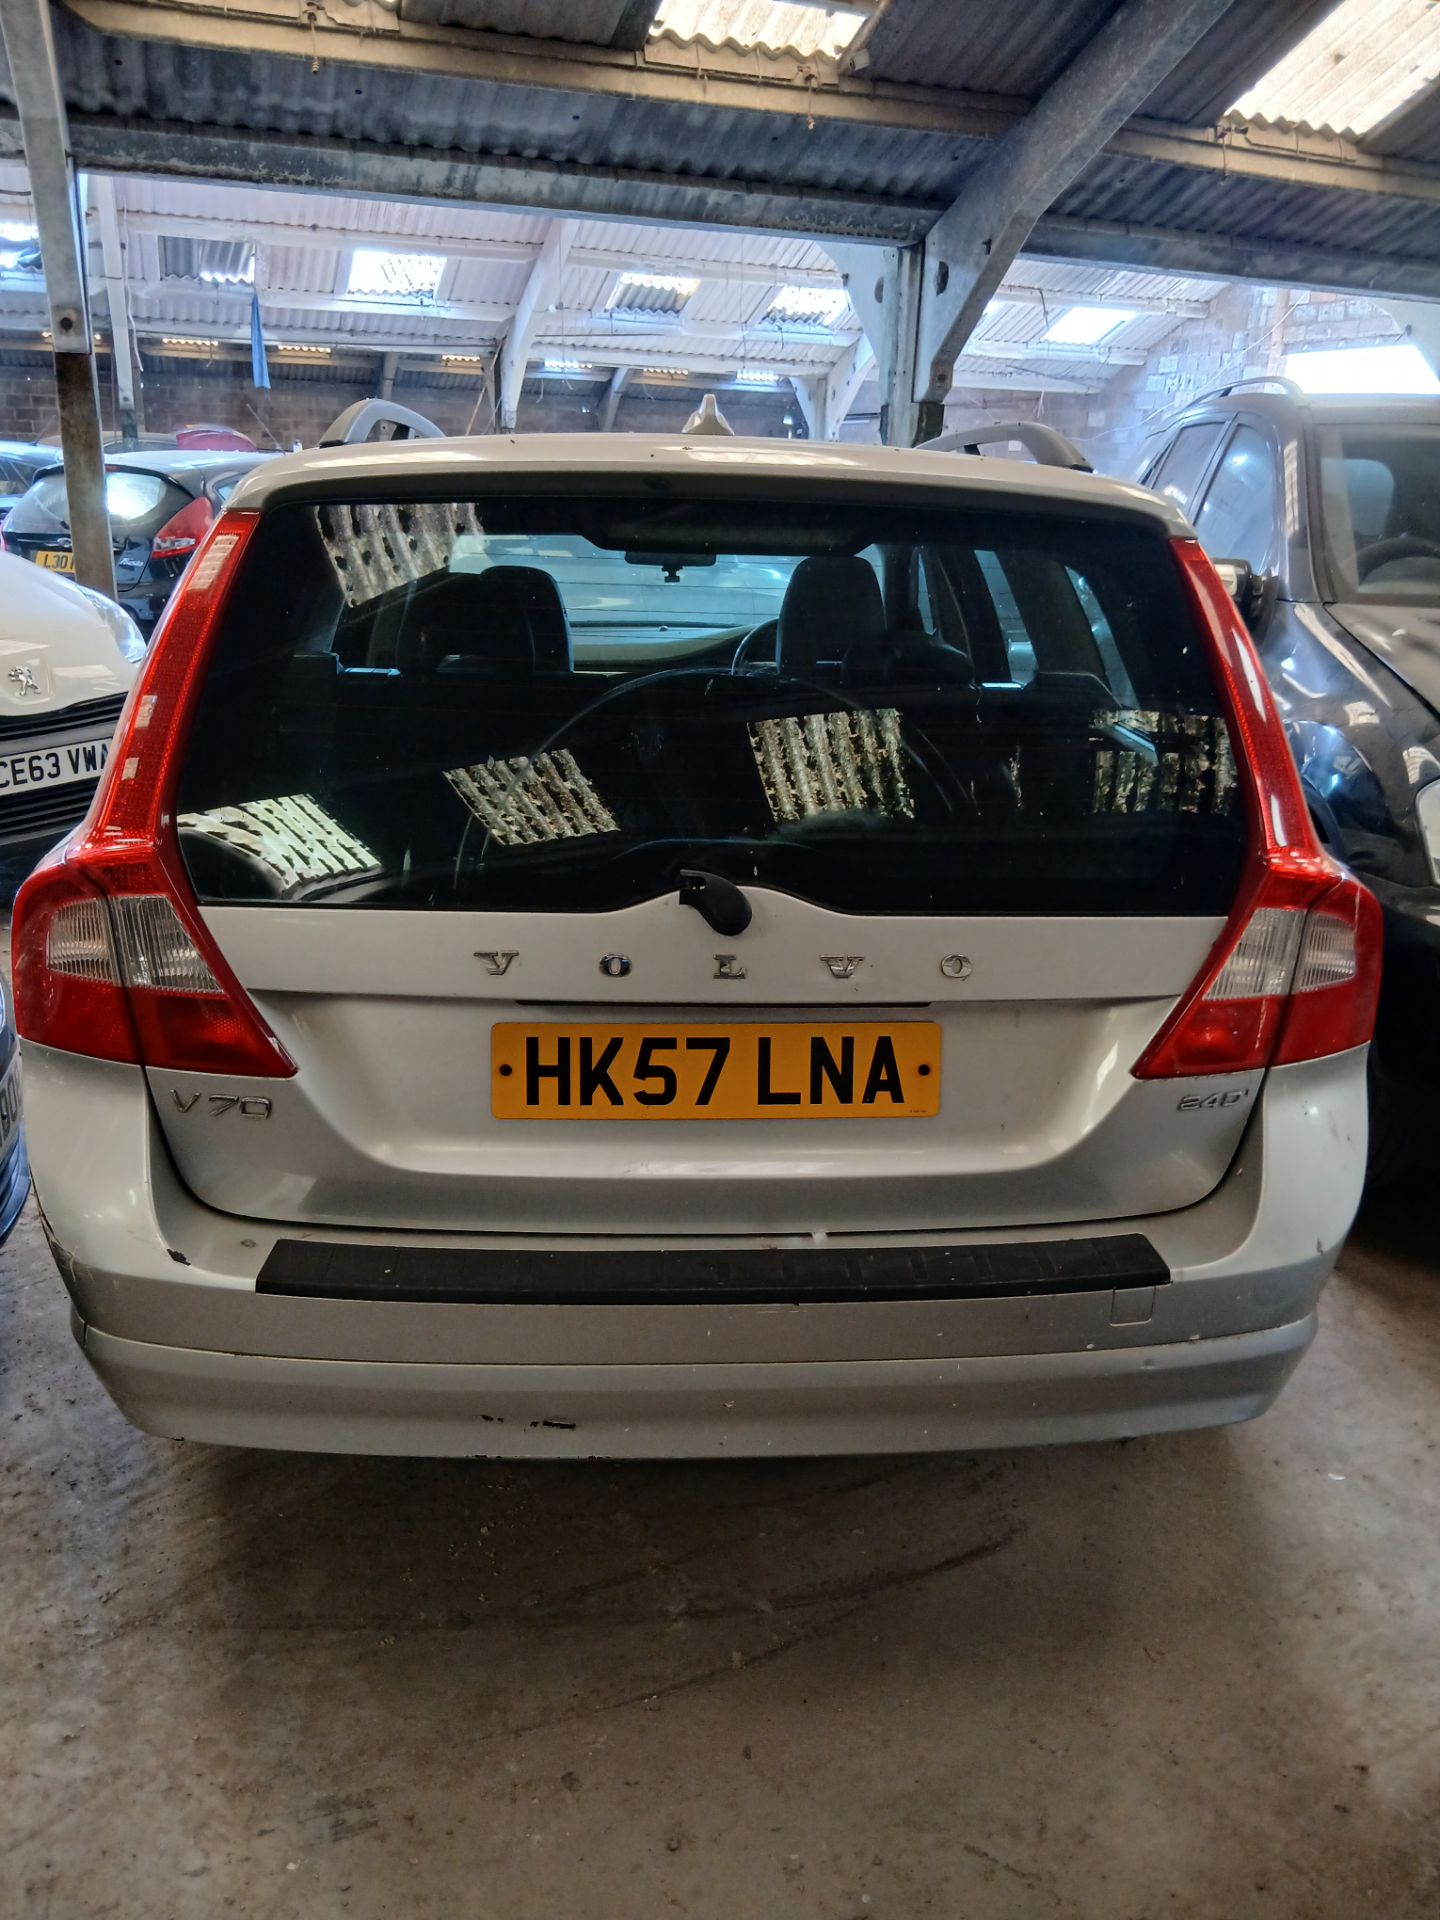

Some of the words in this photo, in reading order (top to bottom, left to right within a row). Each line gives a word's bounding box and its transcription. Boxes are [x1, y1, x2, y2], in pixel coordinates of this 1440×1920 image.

[473, 952, 973, 982] VOLVO
[526, 1036, 731, 1106] HK57
[757, 1036, 905, 1105] LNA
[169, 1088, 272, 1120] V70
